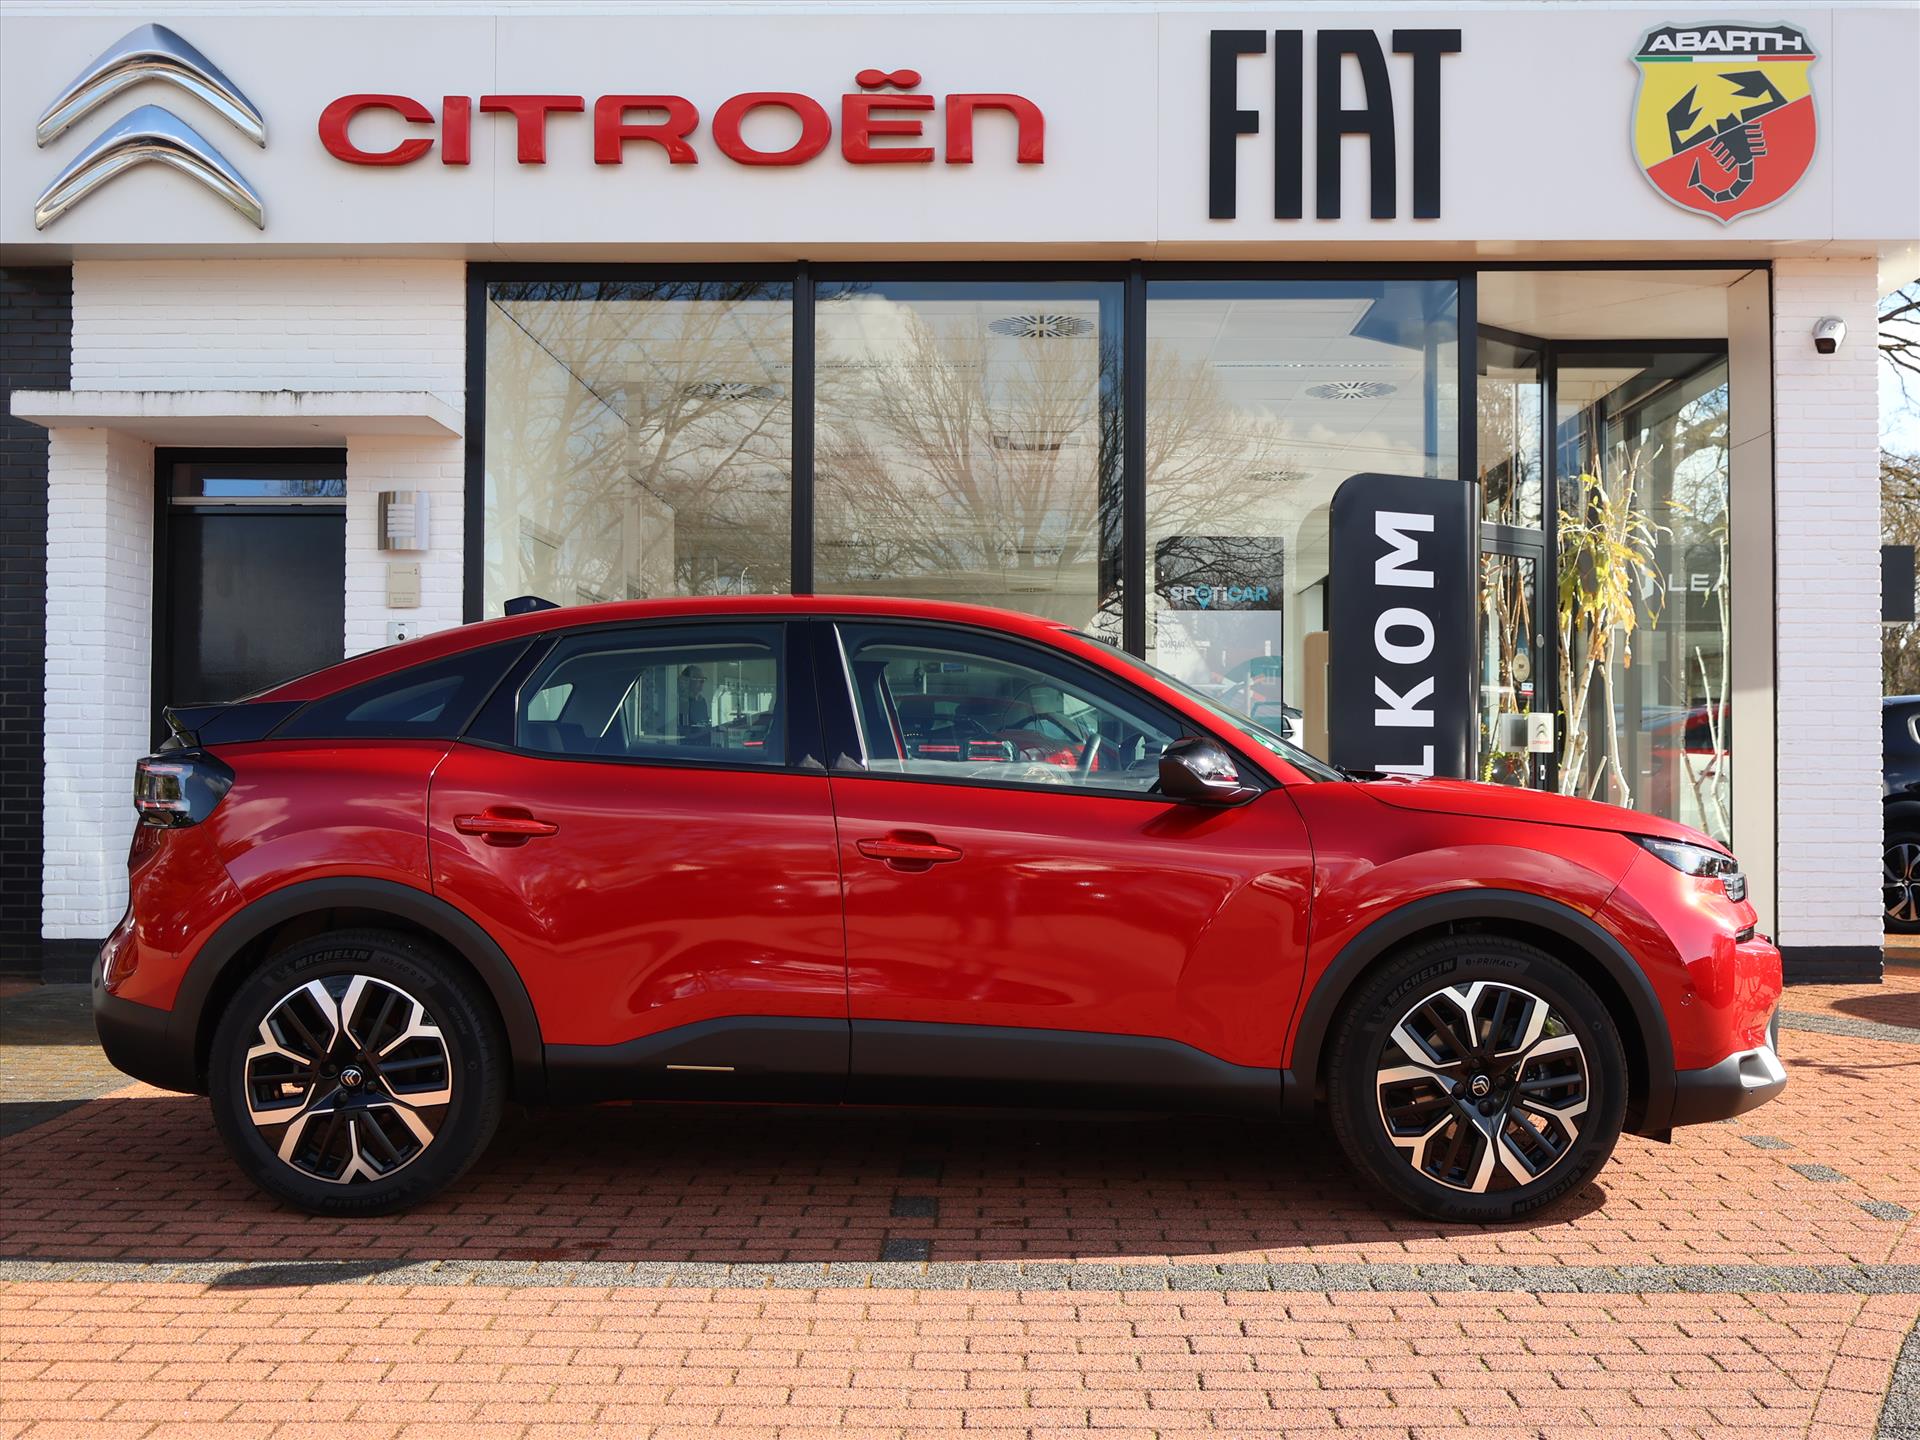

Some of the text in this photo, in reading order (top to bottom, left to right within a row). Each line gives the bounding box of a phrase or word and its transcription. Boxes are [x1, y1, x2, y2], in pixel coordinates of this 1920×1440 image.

[1647, 34, 1803, 53] ABARTH
[319, 69, 1046, 166] CITROËN
[1209, 29, 1462, 220] FIAT
[296, 949, 370, 969] MICHELIN
[1387, 958, 1457, 1005] MICHELIN
[1513, 1170, 1582, 1214] MICHELIN
